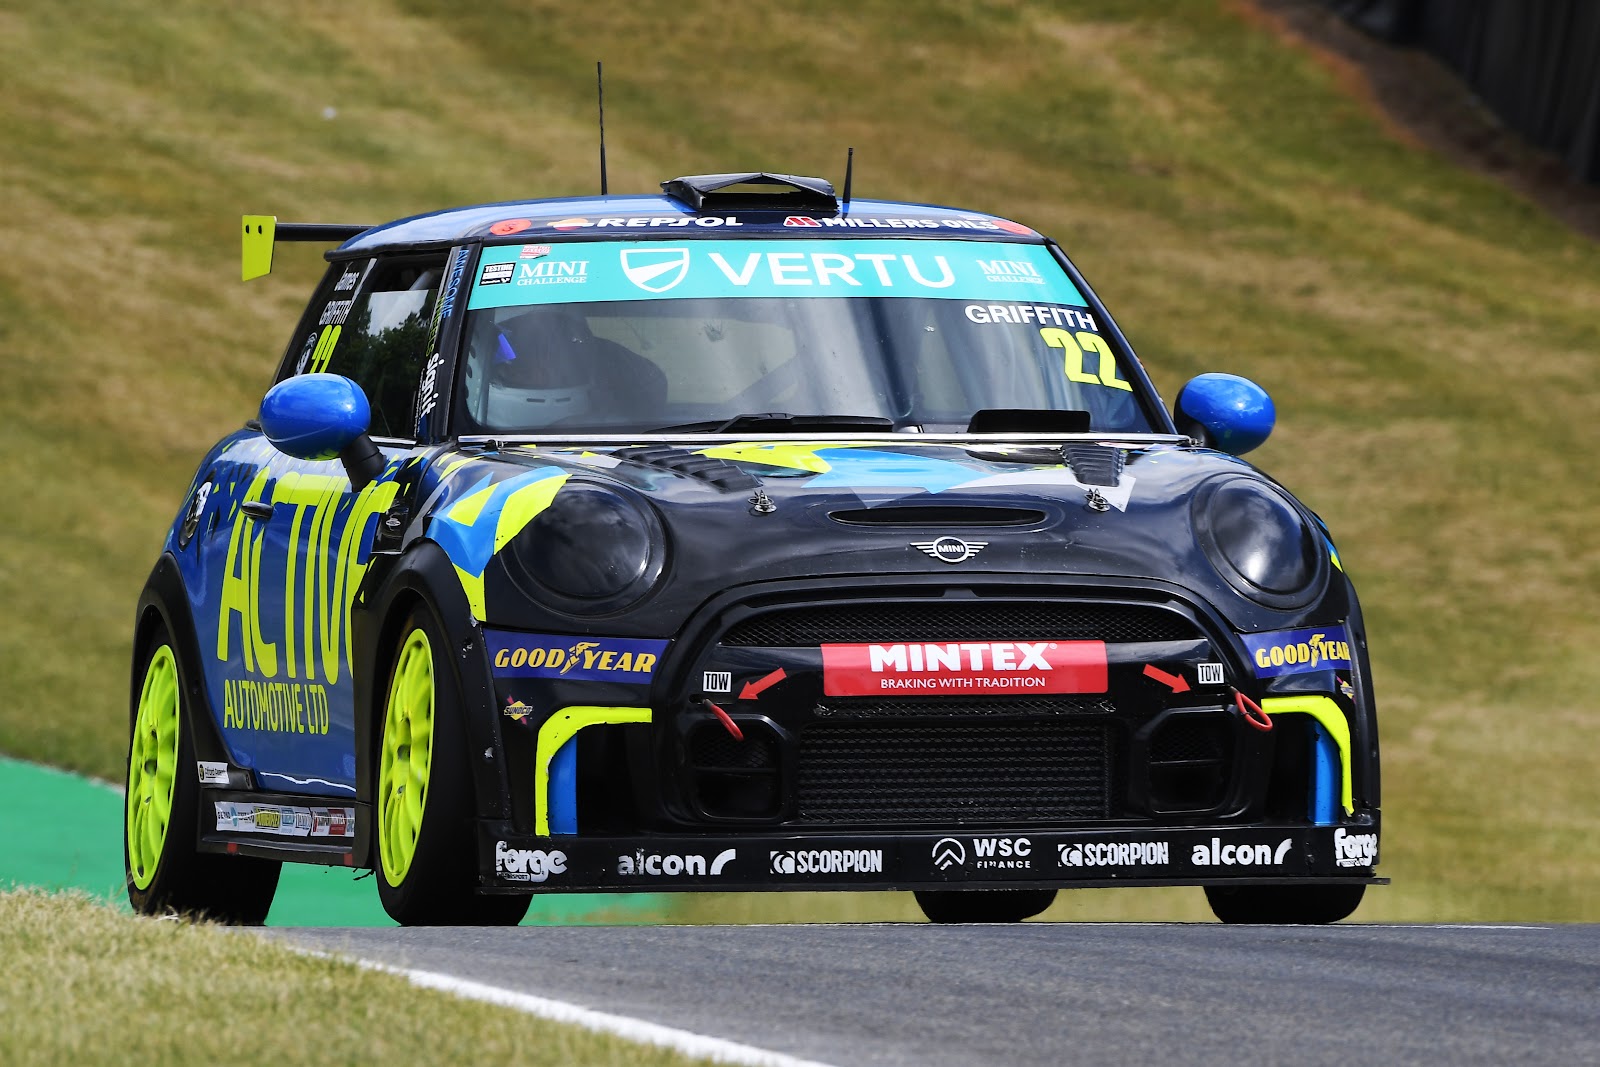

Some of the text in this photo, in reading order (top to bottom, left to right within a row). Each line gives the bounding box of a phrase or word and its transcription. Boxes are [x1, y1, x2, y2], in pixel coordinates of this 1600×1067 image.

[597, 217, 743, 227] REPSOL
[821, 217, 1000, 230] MILLERS OILS
[519, 261, 590, 278] MINI
[708, 252, 956, 289] VERTU
[976, 260, 1041, 277] MINI
[440, 249, 470, 319] AWESOME
[517, 276, 587, 286] CHALLENGE
[964, 304, 1099, 332] GRIFFITH
[1040, 327, 1133, 392] 22
[937, 544, 965, 554] MINI
[217, 466, 400, 685] ACTIVE
[494, 647, 657, 674] GOODYEAR
[868, 642, 1054, 672] MINTEX
[705, 673, 730, 691] TOW
[880, 677, 1046, 689] BRAKING WITH TRADITION
[1200, 664, 1221, 682] TOW
[223, 679, 329, 735] AUTOMOTIVE LTD
[973, 838, 1032, 857] WSC
[1084, 841, 1169, 866] SCORPION
[1191, 837, 1272, 865] alcon
[496, 841, 568, 882] forge
[617, 847, 707, 875] alcon
[796, 850, 882, 873] SCORPION
[976, 861, 1031, 869] FINANCE
